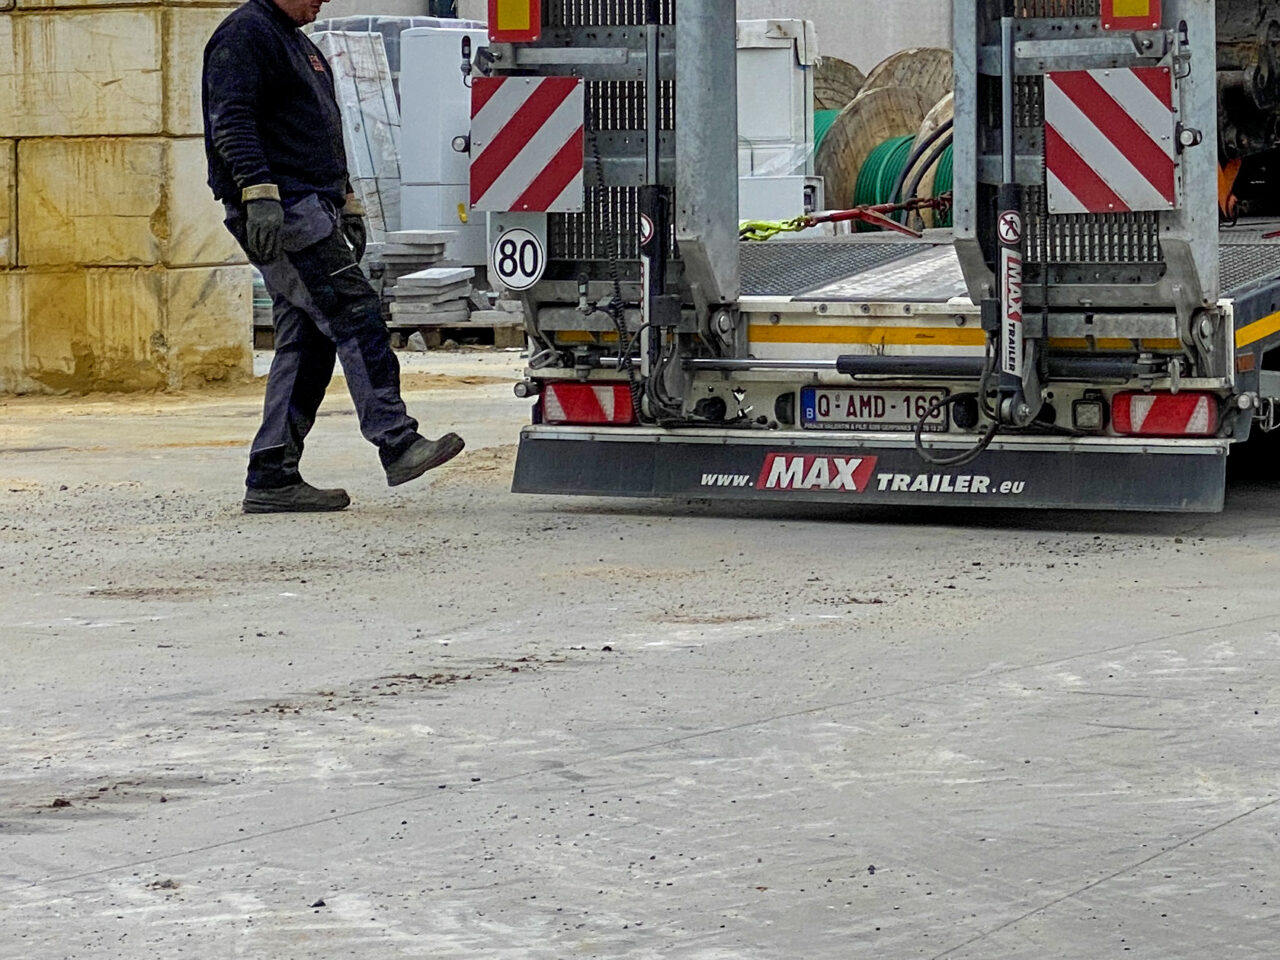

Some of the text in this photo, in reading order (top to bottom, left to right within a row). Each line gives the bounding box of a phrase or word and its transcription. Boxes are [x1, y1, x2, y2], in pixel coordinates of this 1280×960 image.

[498, 239, 538, 278] 80
[1007, 260, 1022, 372] MAX TRAILER
[806, 408, 814, 419] B
[765, 456, 864, 491] MAX
